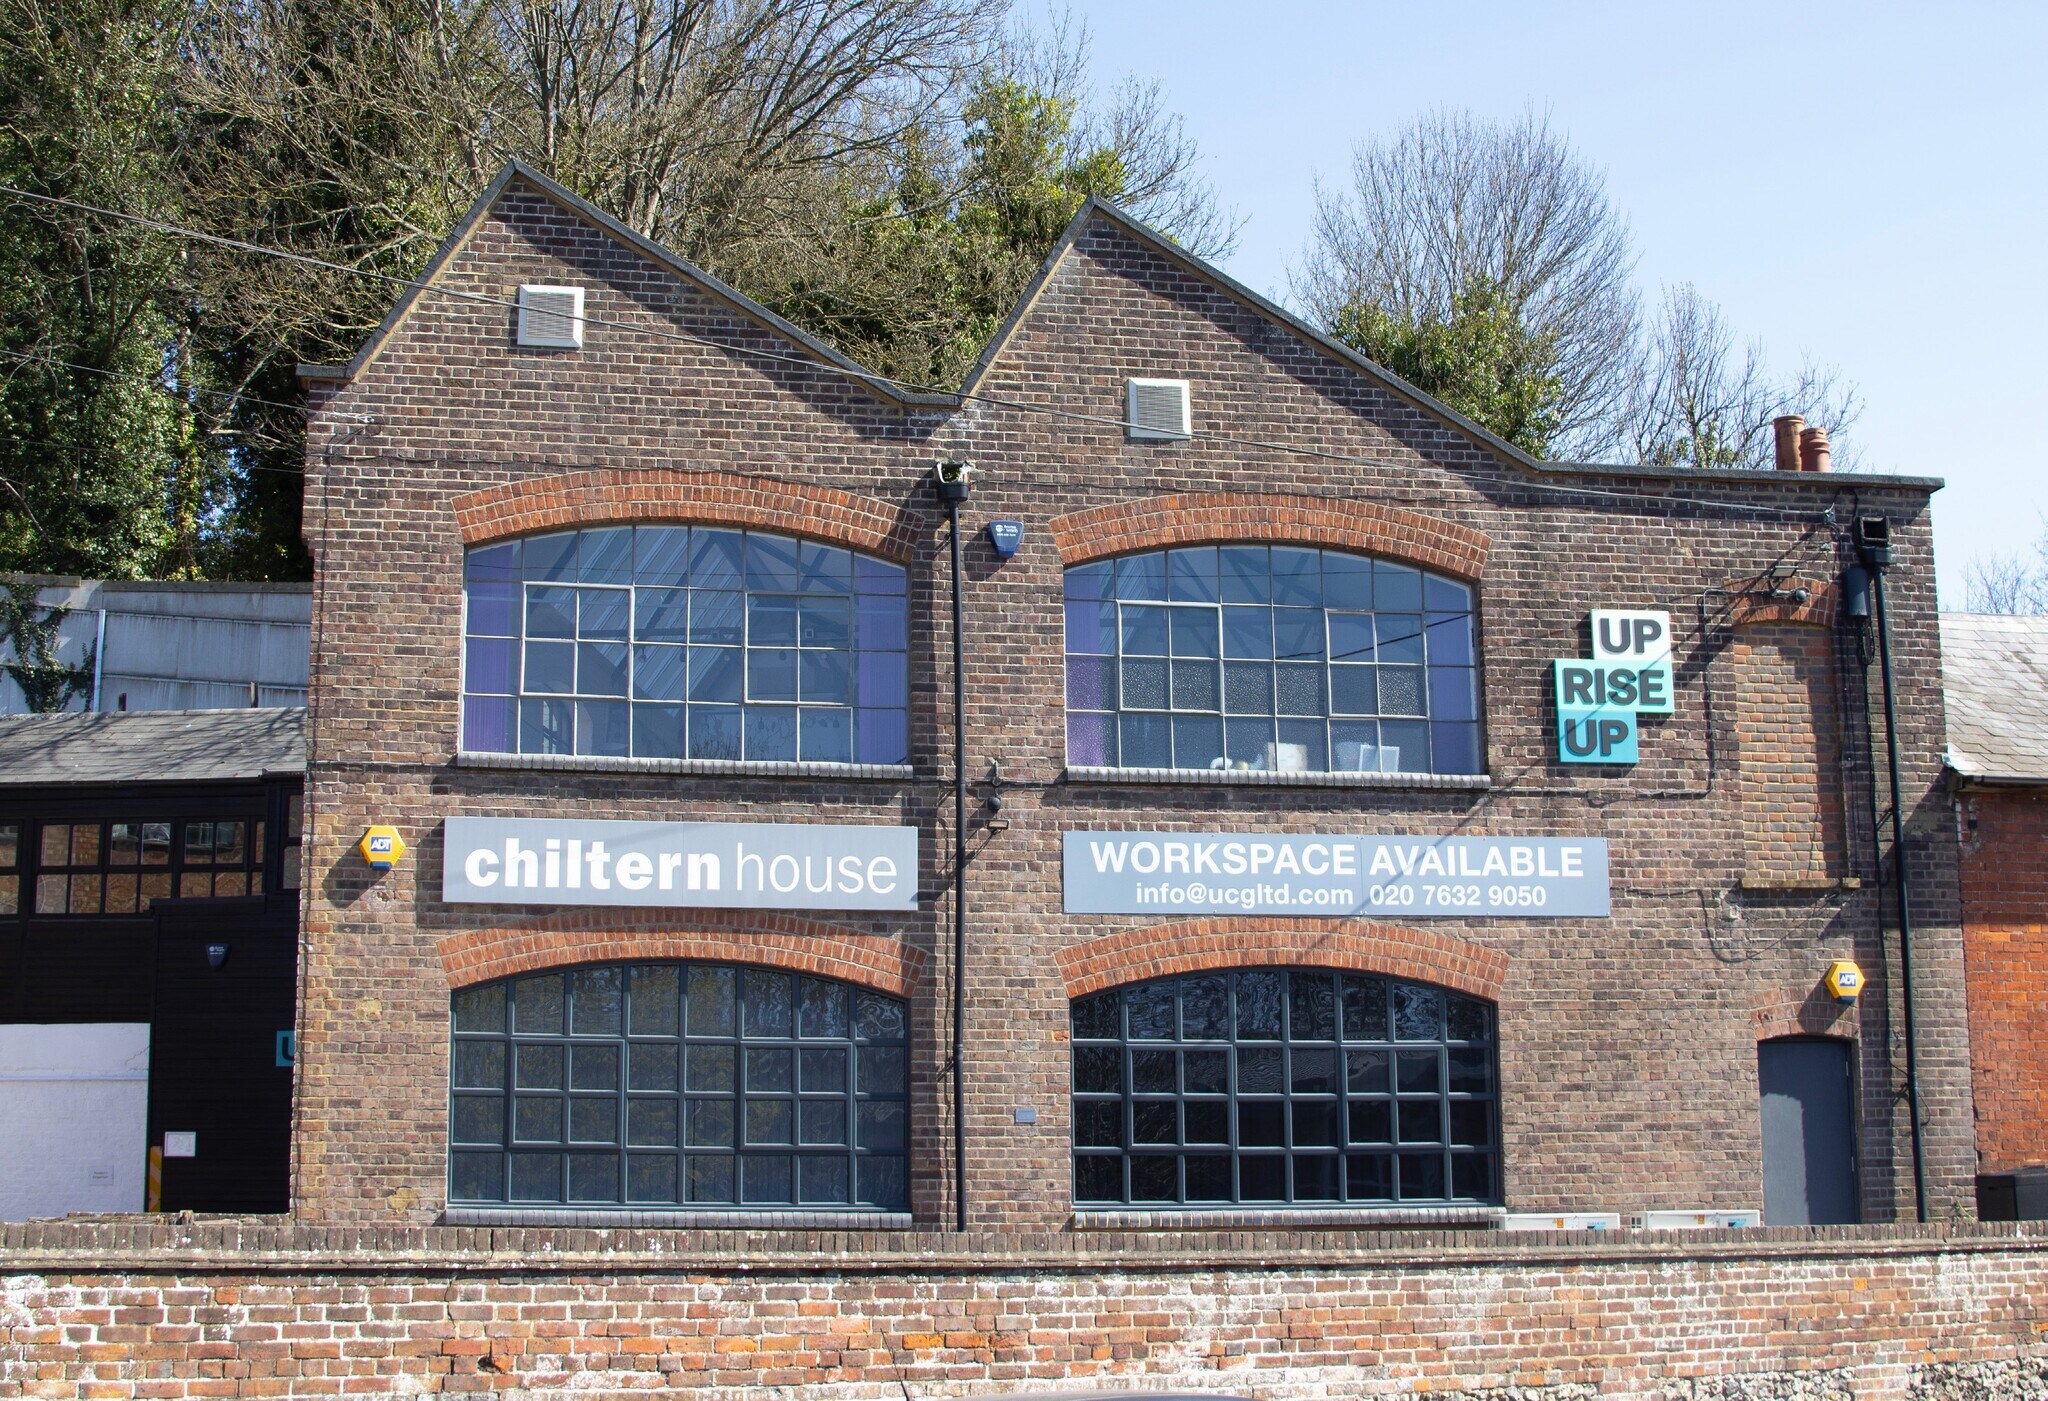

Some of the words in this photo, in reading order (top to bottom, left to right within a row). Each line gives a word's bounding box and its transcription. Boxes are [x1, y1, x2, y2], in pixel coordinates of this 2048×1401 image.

[1599, 618, 1662, 655] UP
[1562, 667, 1667, 706] RISE
[1564, 718, 1629, 757] UP
[371, 839, 392, 850] ADT
[1090, 840, 1357, 876] WORKSPACE
[1369, 845, 1584, 878] AVAILABLE
[464, 837, 721, 891] chiltern
[736, 842, 897, 894] house
[1136, 882, 1353, 909] info@ucgltd.com
[1370, 884, 1414, 906] 020
[1422, 885, 1481, 907] 7632
[1488, 885, 1547, 907] 9050
[1840, 974, 1856, 985] ADT
